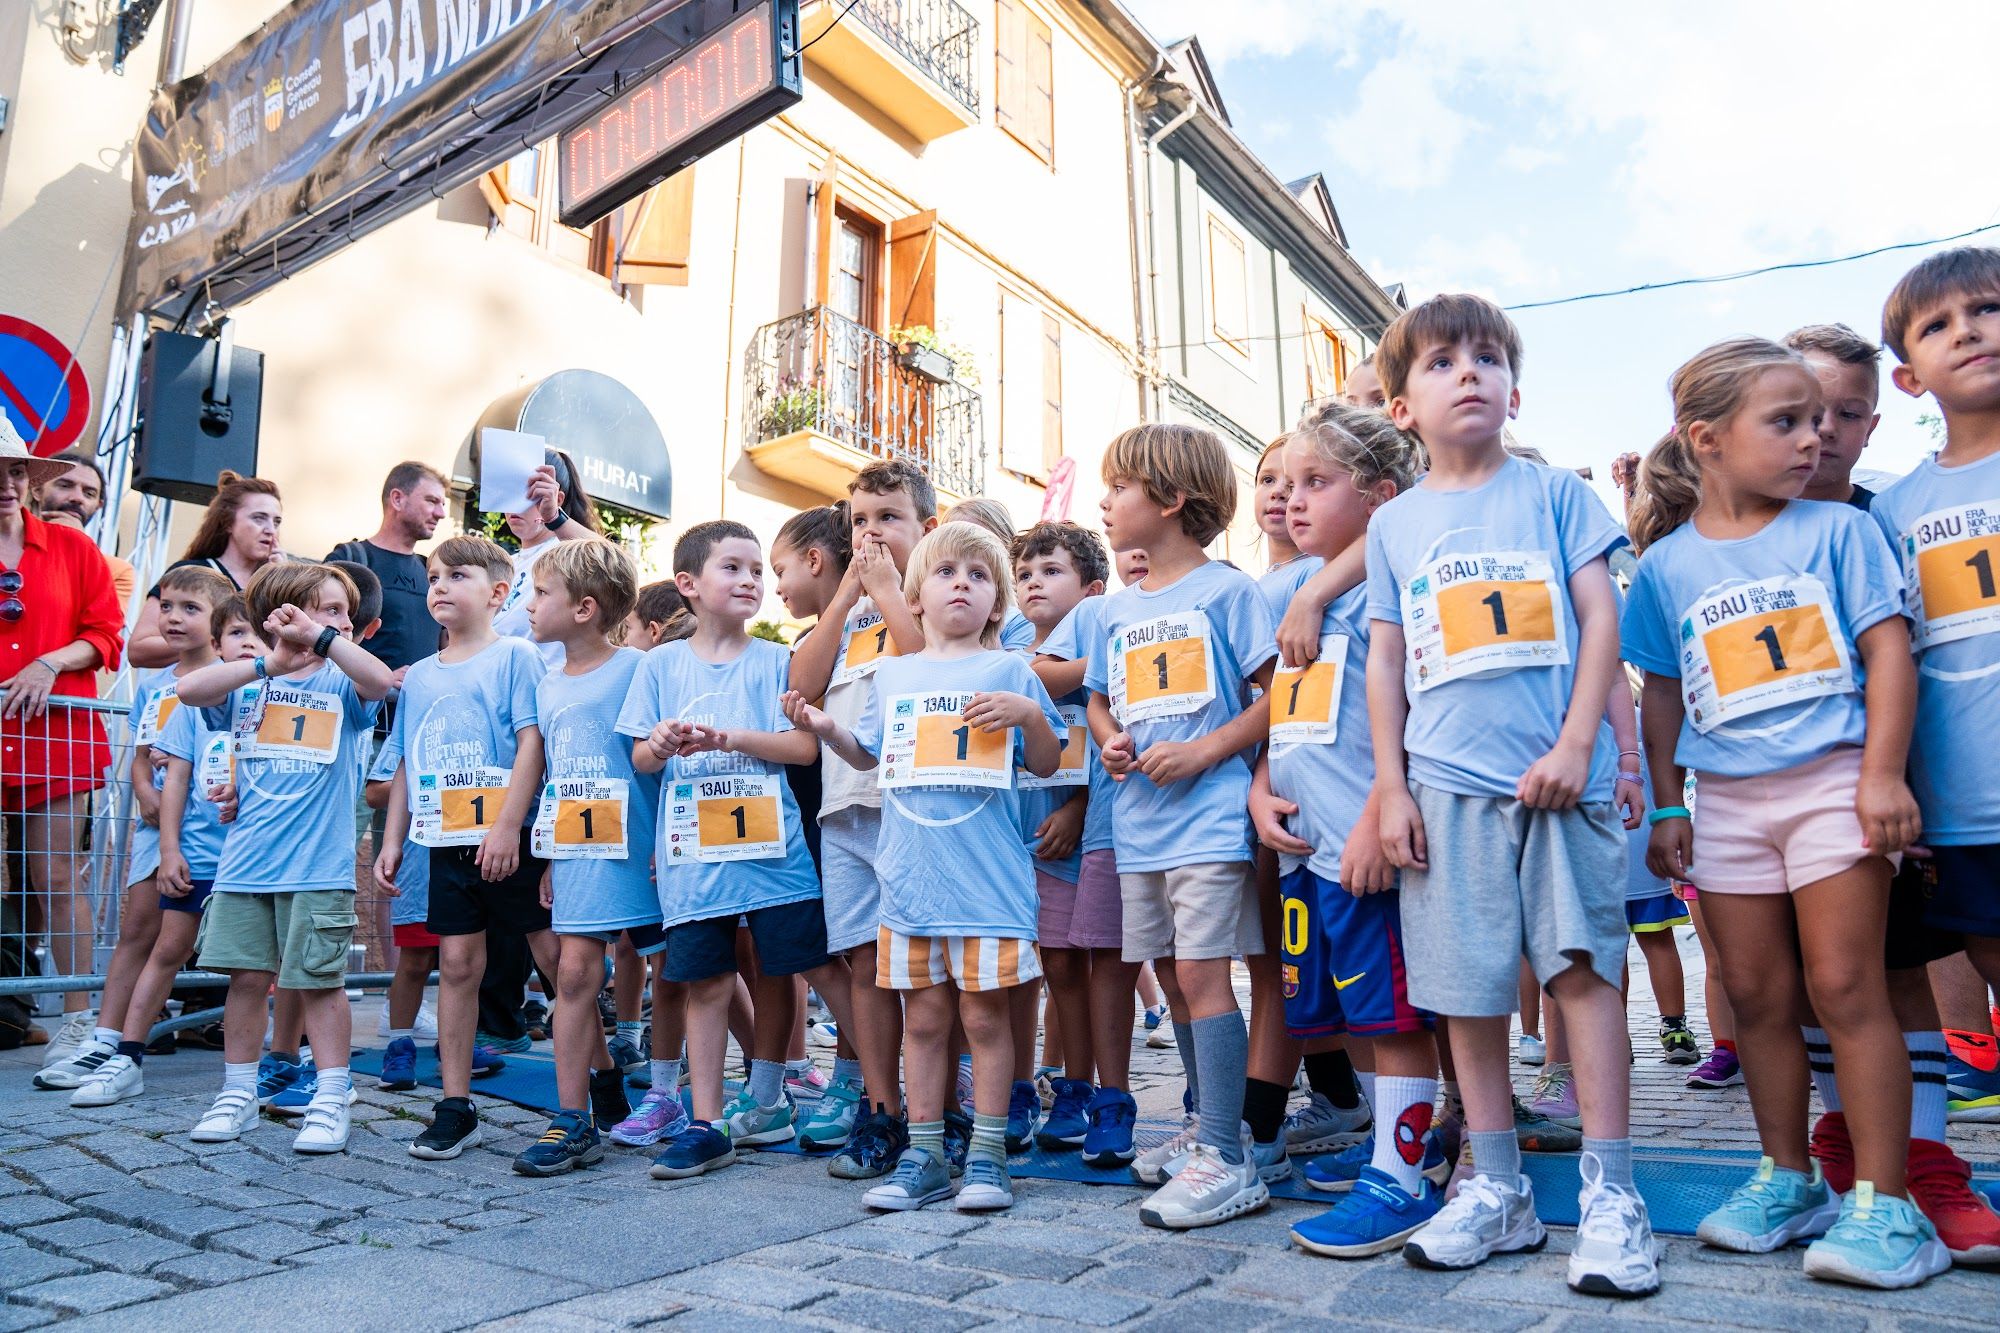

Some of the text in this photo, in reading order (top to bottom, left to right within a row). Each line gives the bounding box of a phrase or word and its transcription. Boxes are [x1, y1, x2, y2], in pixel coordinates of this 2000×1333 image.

[285, 58, 321, 91] Conselh
[329, 0, 426, 137] ERA
[289, 92, 320, 120] d'Aran
[571, 18, 762, 200] 00:00:00
[582, 455, 652, 495] HURAT
[1965, 508, 1986, 519] ERA
[1917, 515, 1962, 546] 13AU
[1969, 528, 1982, 537] DE
[1436, 560, 1479, 585] 13AU
[1481, 557, 1497, 565] ERA
[1483, 565, 1525, 573] NOCTURNA
[1499, 572, 1526, 580] VIELHA
[1965, 549, 1997, 599] 1
[1748, 586, 1767, 596] ERA
[1750, 589, 1796, 605] NOCTURNA
[1482, 590, 1508, 635] 1
[1700, 594, 1747, 626] 13AU
[1753, 599, 1798, 613] DE VIELHA
[1127, 625, 1154, 647] 13AU
[1157, 619, 1168, 629] ERA
[1157, 624, 1189, 636] NOCTURNA
[875, 627, 888, 654] 1
[1157, 631, 1189, 643] DE VIELHA
[1754, 624, 1788, 672] 1
[1152, 652, 1168, 690] 1
[923, 696, 957, 712] 13AU
[1288, 676, 1304, 715] 1
[291, 714, 306, 741] 1
[426, 740, 484, 765] NOCTURNA
[952, 725, 968, 760] 1
[271, 760, 319, 774] VIELHA
[681, 756, 755, 777] DE VIELHA
[560, 783, 583, 797] 13AU
[700, 780, 731, 797] 13AU
[471, 795, 484, 825] 1
[730, 806, 746, 838] 1
[579, 808, 593, 838] 1
[1369, 1187, 1392, 1204] GEOX
